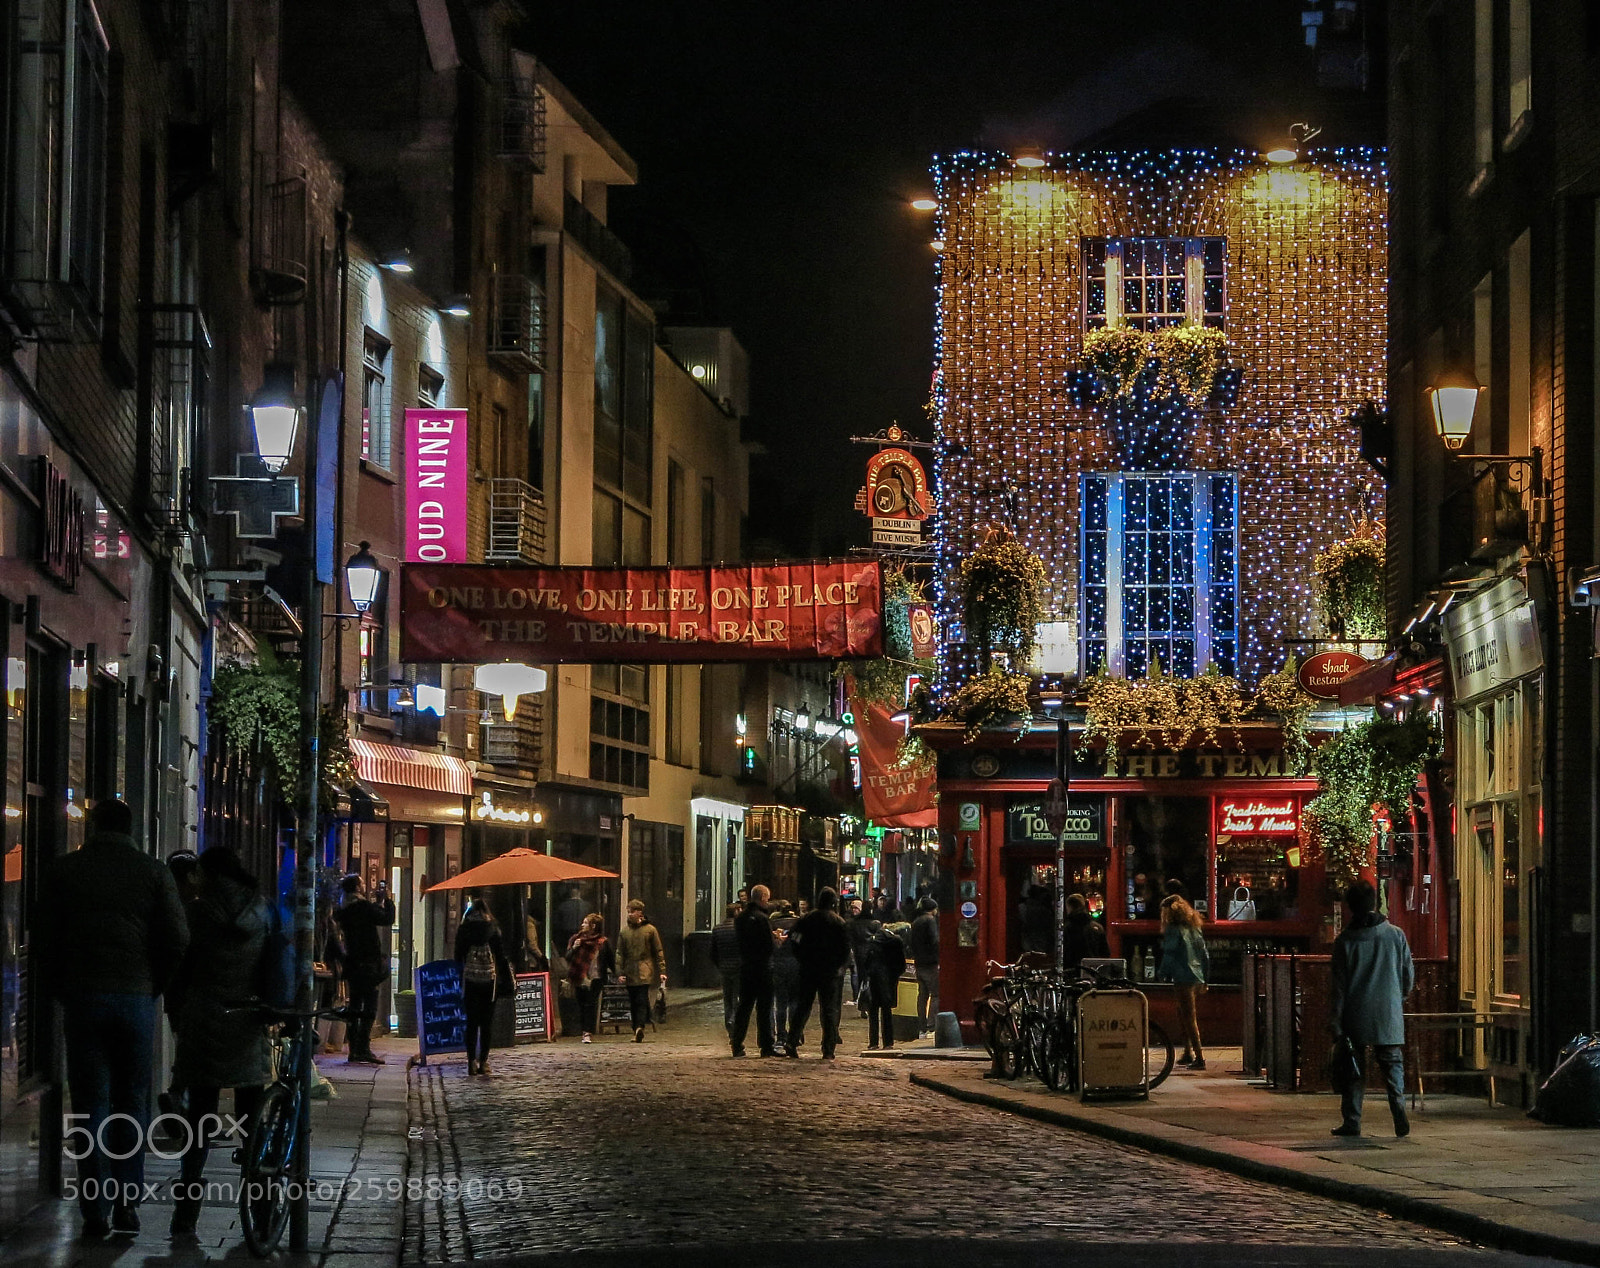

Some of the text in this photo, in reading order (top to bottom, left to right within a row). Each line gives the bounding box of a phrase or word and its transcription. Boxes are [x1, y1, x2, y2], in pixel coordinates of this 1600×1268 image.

[418, 419, 454, 488] NINE
[877, 452, 913, 468] TEMPLE
[882, 520, 911, 529] DUBLIN
[876, 532, 918, 543] LIVE MUSIC
[428, 581, 859, 614] ONE LOVE, ONE LIFE, ONE PLACE
[478, 620, 547, 642] THE
[566, 620, 699, 643] TEMPLE
[717, 619, 787, 643] BAR
[1322, 658, 1350, 675] Shack
[1098, 755, 1181, 777] THE
[868, 767, 929, 788] TEMPLE
[885, 783, 918, 798] BAR
[1223, 801, 1293, 817] Traditional
[1222, 817, 1296, 831] Irish Music
[515, 992, 541, 1000] OFFEE
[1088, 1018, 1137, 1032] ARIOSA
